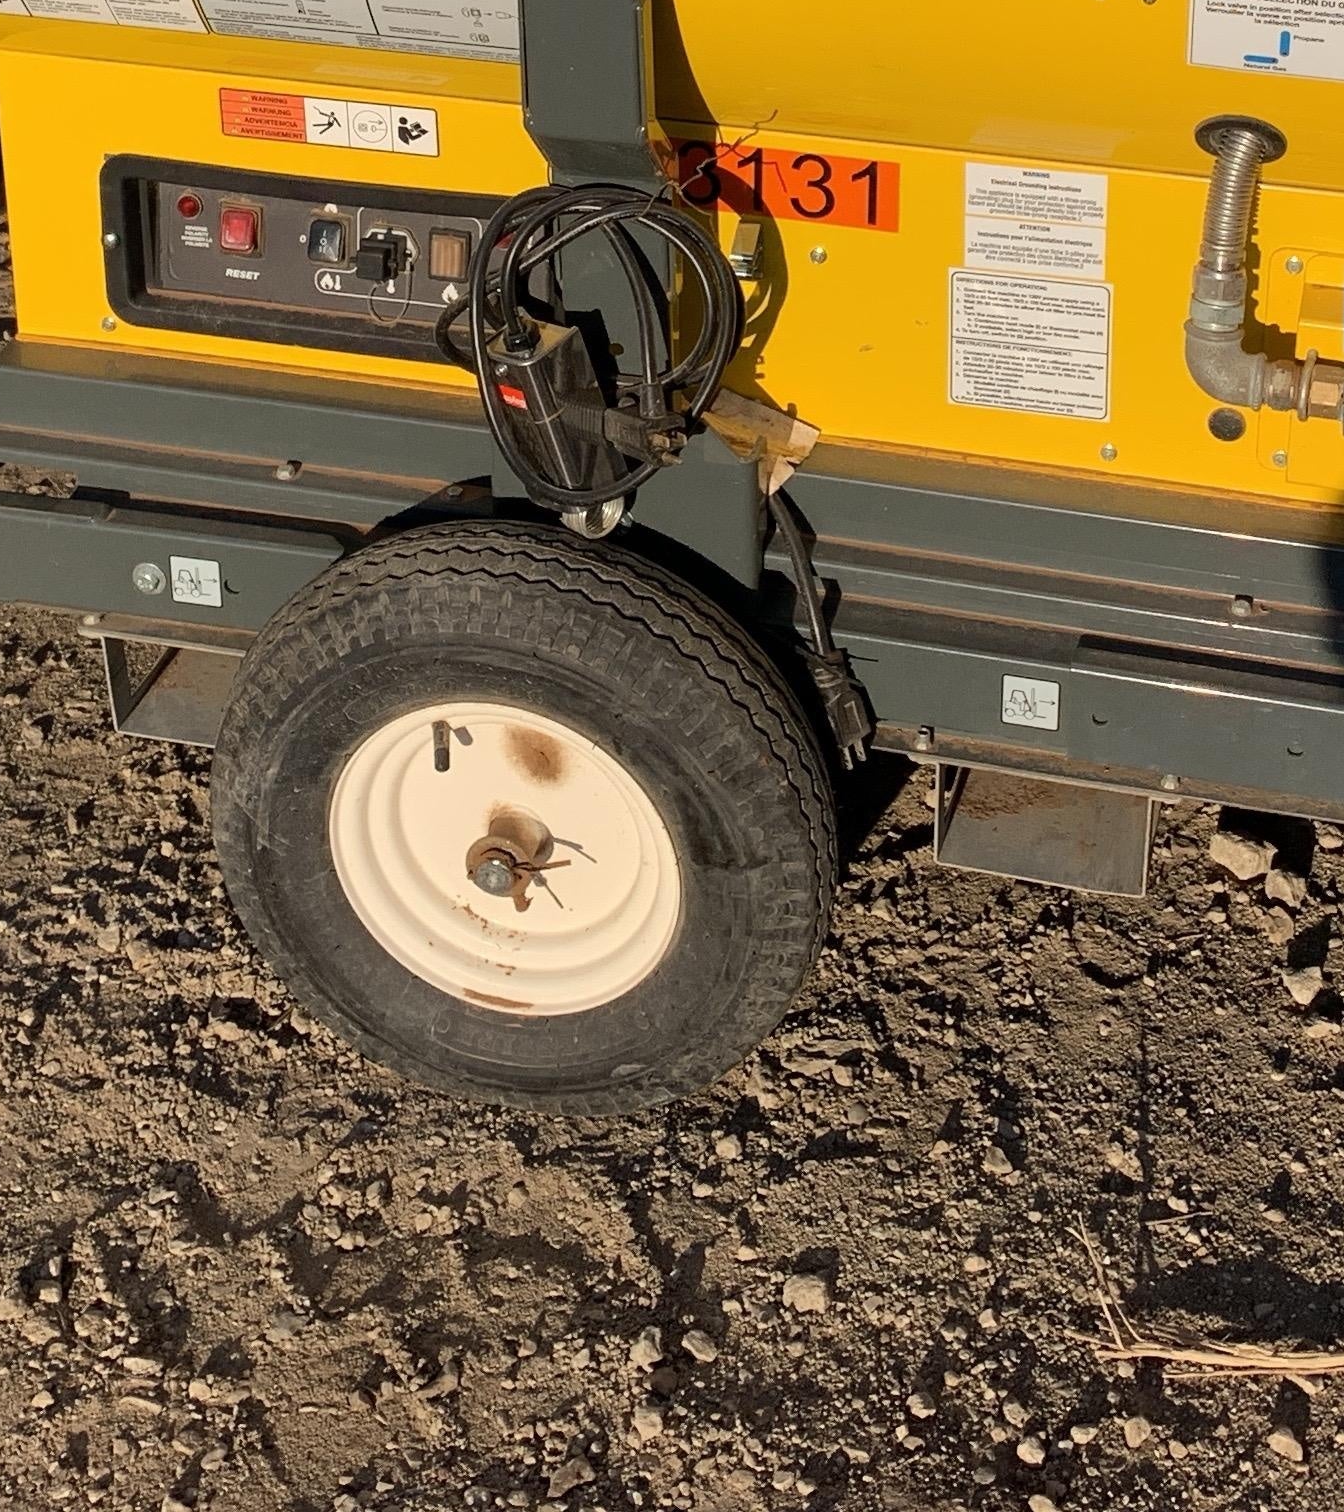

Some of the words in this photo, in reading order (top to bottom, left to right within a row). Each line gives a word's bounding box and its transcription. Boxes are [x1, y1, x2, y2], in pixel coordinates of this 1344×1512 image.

[1206, 0, 1225, 8] Lock
[1226, 1, 1247, 10] valve
[1249, 3, 1256, 11] in
[1258, 4, 1290, 15] position
[1292, 7, 1312, 16] after
[1320, 0, 1336, 8] DU
[250, 95, 288, 104] WARNING
[677, 140, 878, 226] 3131
[225, 267, 260, 281] RESET
